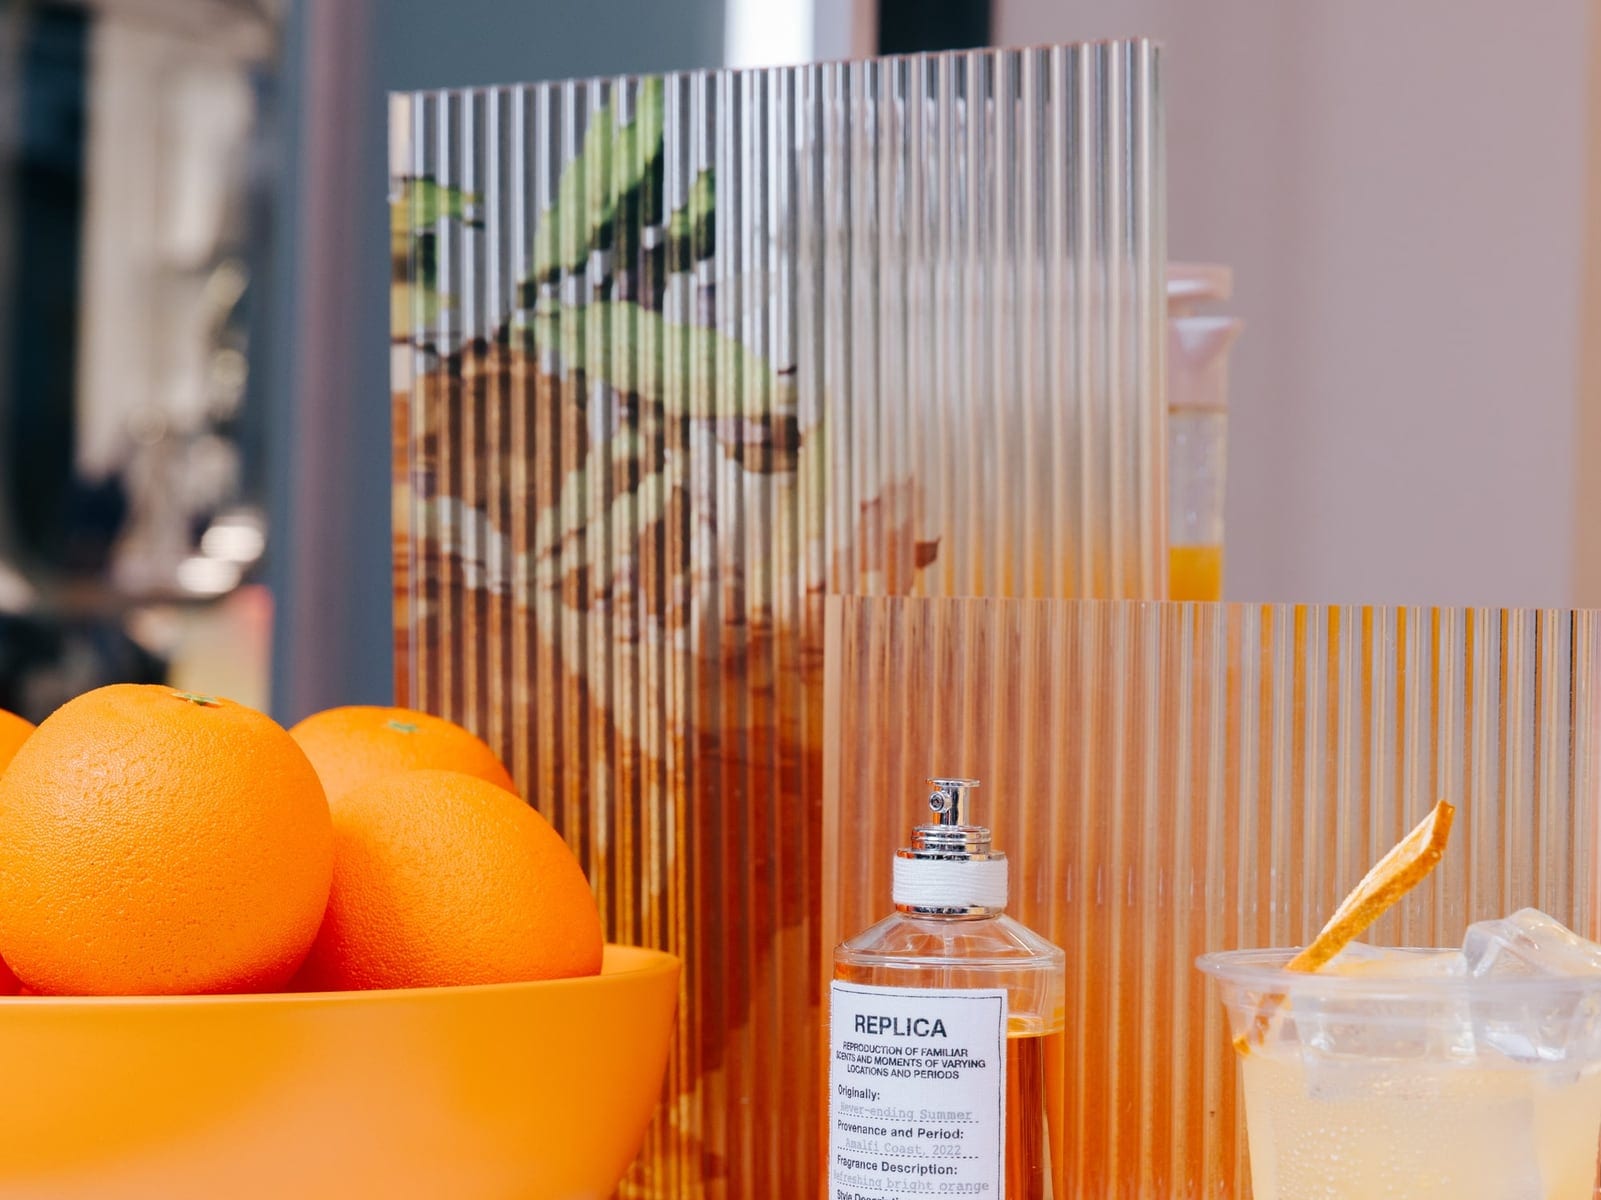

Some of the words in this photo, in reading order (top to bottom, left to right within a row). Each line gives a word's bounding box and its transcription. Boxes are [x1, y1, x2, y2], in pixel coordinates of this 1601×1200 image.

[855, 1014, 947, 1038] REPLICA
[843, 1041, 903, 1056] REPRODUCTION
[905, 1047, 918, 1056] OF
[921, 1049, 969, 1058] FAMILIAR
[836, 1050, 856, 1062] SCENTS
[857, 1054, 873, 1065] AND
[874, 1056, 923, 1068] MOMENTS
[924, 1059, 939, 1068] OF
[942, 1059, 986, 1069] VARYING
[847, 1064, 889, 1077] LOCATIONS
[891, 1069, 912, 1079] AND
[913, 1070, 960, 1080] PERIODS
[837, 1084, 880, 1102] Originally:
[840, 1101, 914, 1121] Never-ending
[919, 1108, 973, 1121] Summer
[837, 1119, 887, 1136] Provenance
[890, 1127, 913, 1139] and
[917, 1128, 964, 1140] Period:
[845, 1137, 881, 1152] Amalfi
[884, 1142, 927, 1157] Coast,
[932, 1144, 962, 1156] 2022
[837, 1154, 878, 1171] Fragrance
[881, 1161, 958, 1177] Description:
[886, 1176, 934, 1193] bright
[939, 1182, 990, 1194] orange
